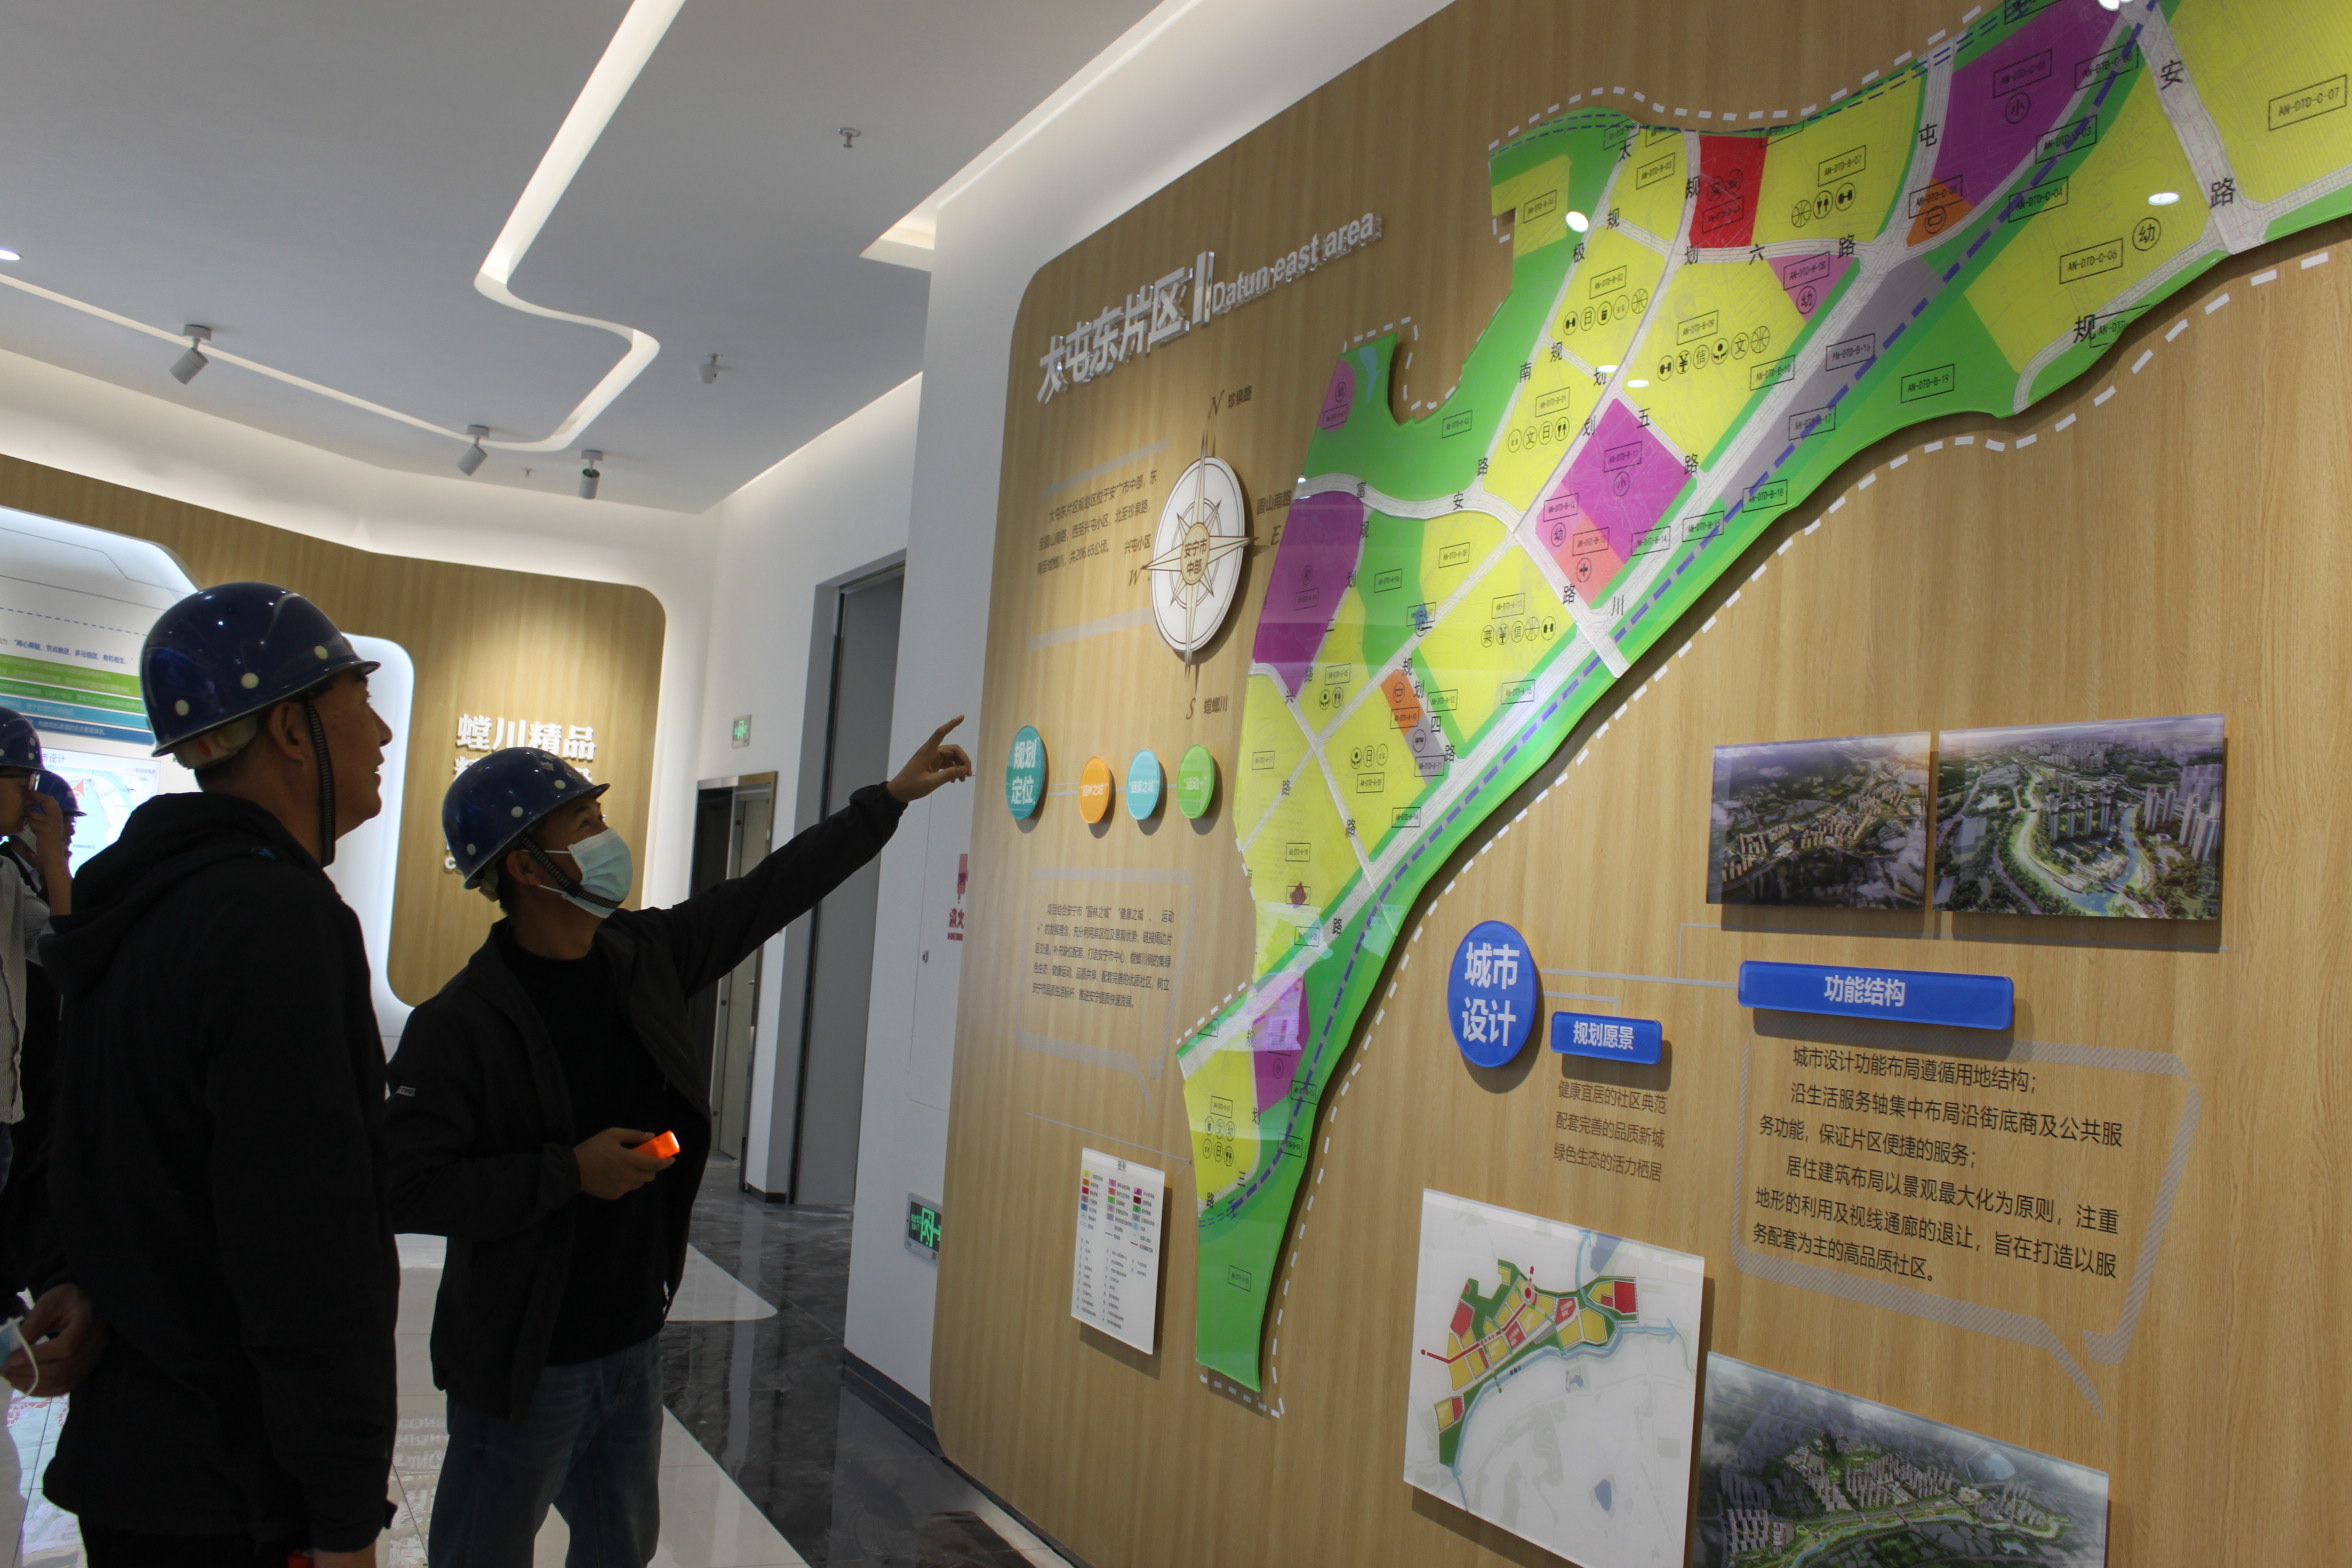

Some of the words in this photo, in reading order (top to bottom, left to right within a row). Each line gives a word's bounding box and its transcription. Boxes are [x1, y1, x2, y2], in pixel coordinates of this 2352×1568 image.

[2278, 86, 2340, 118] AN-DTD-C-07
[1918, 124, 1938, 147] 屯
[2160, 59, 2185, 91] 安
[2209, 177, 2236, 210] 路
[1617, 140, 1632, 163] 太
[1685, 176, 1700, 199] 规
[1606, 207, 1620, 230] 规
[1684, 245, 1699, 266] 划
[1749, 243, 1766, 266] 六
[1838, 233, 1856, 258] 路
[1212, 266, 1276, 314] Datun
[1273, 232, 1321, 284] east
[1324, 212, 1382, 256] area
[1573, 243, 1585, 264] 极
[2067, 248, 2118, 272] AN-DTD-C-06
[2073, 313, 2097, 343] 规
[1519, 361, 1532, 384] 南
[1208, 389, 1225, 419] N
[1550, 341, 1563, 363] 规
[1593, 368, 1607, 386] 划
[1636, 408, 1651, 429] 五
[1684, 453, 1699, 475] 路
[1582, 415, 1596, 437] 划
[1477, 456, 1489, 477] 路
[1183, 538, 1207, 558] 安宁市
[1270, 525, 1281, 546] E
[1453, 491, 1464, 511] 安
[1562, 584, 1576, 605] 路
[1128, 568, 1142, 587] W
[1186, 558, 1203, 577] 中部
[1610, 594, 1625, 617] 川
[1186, 697, 1196, 719] S
[1401, 658, 1413, 677] 规
[1430, 716, 1442, 733] 四
[1444, 743, 1456, 763] 路
[456, 713, 597, 761] 螳川精品
[1013, 737, 1039, 769] 规划
[1010, 775, 1036, 805] 定位
[1331, 916, 1343, 936] 路
[1464, 941, 1520, 990] 城市
[1824, 974, 1907, 1007] 功能结构
[1461, 996, 1517, 1047] 设计
[1572, 1020, 1635, 1051] 规划愿景
[1557, 1079, 1668, 1115] 健康宜居的社区典范
[1555, 1111, 1665, 1149] 配套完善的品质新城
[1790, 1082, 2124, 1148] 沿生活服务轴集中布局沿街底商及公共服
[1553, 1142, 1663, 1183] 绿色生态的活力栖居
[1786, 1155, 2119, 1235] 居住建筑布局以景观最大化为原则，注重
[1755, 1186, 2117, 1278] 地形的利用及视线通廊的退让，旨在打造以服
[1752, 1222, 1935, 1283] 务配套为主的高品质社区。
